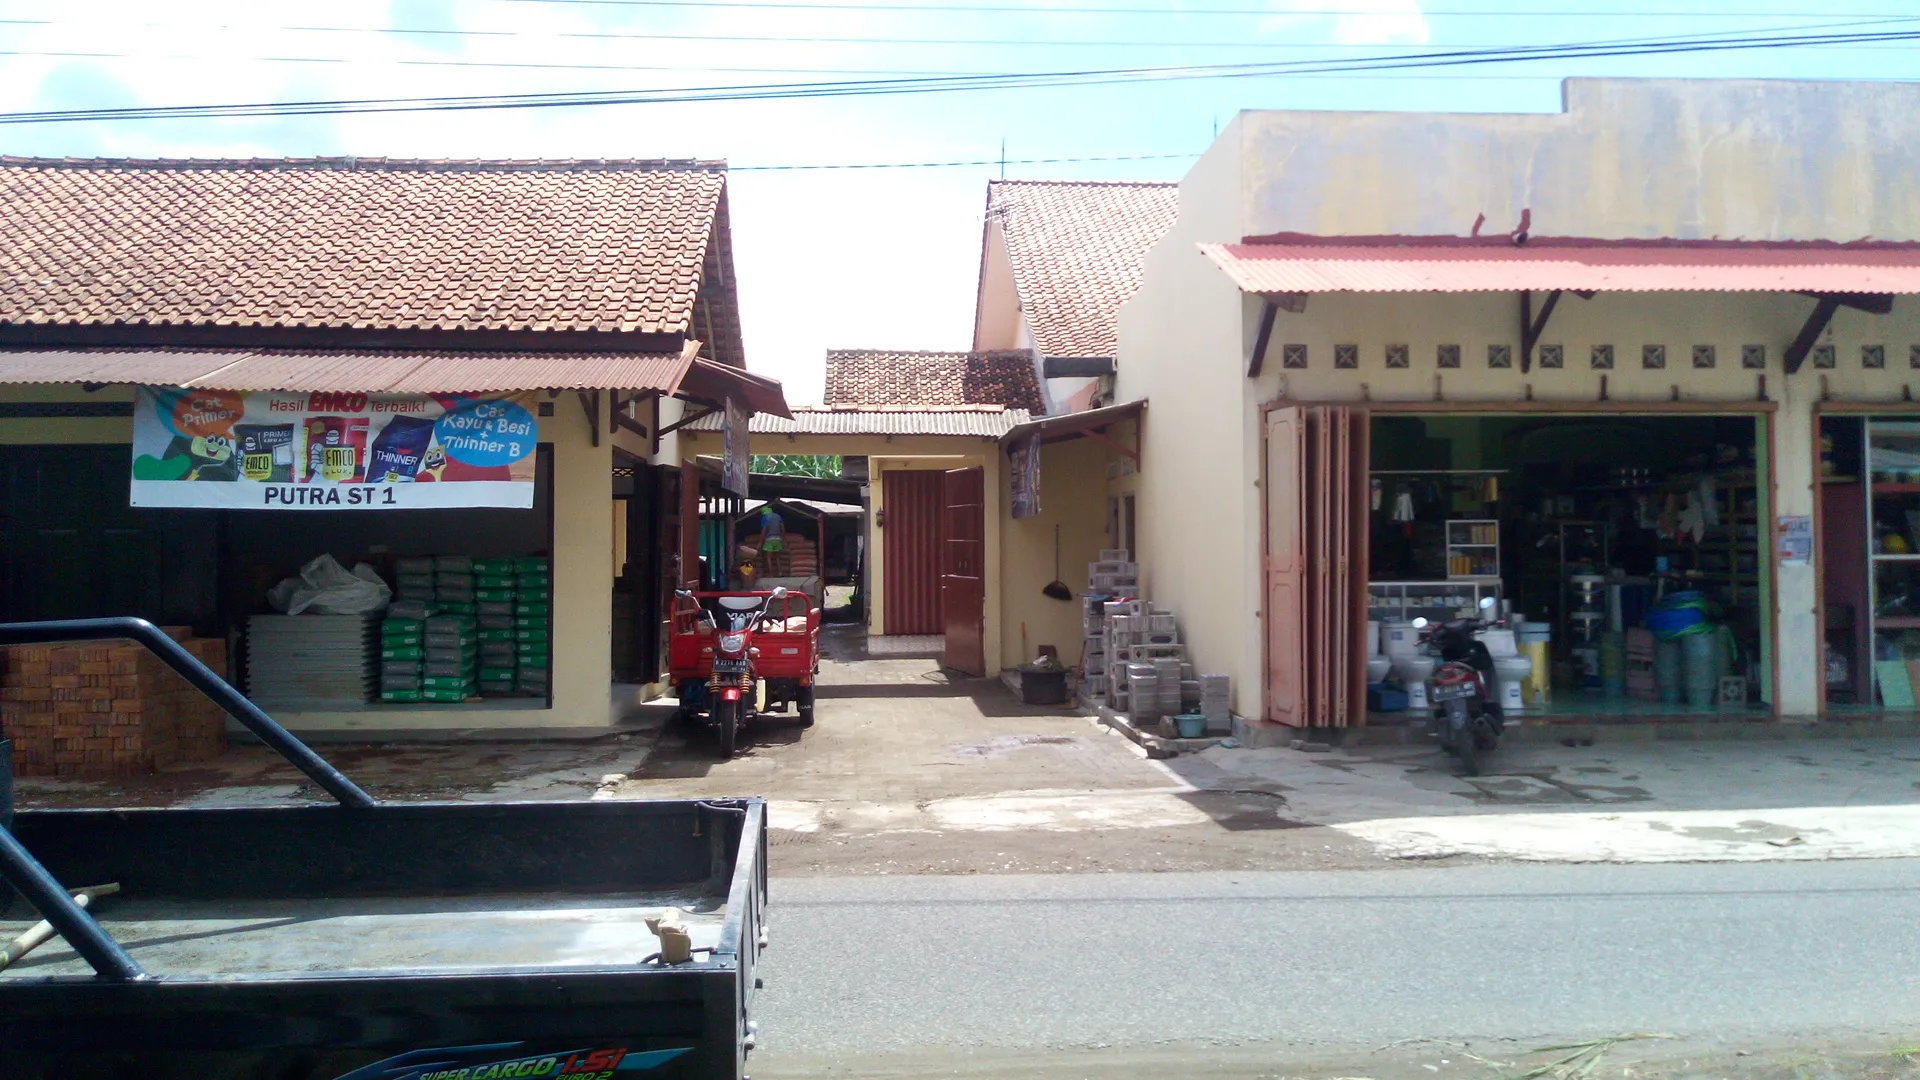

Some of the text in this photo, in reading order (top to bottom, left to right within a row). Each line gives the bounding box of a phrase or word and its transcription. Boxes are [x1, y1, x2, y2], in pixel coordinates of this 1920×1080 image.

[191, 396, 224, 412] Cat
[269, 391, 426, 413] Hasil EMCO Terbaik!
[182, 409, 236, 427] Primer
[442, 413, 531, 436] Kayu & Besi
[443, 435, 521, 457] Thinner B
[245, 455, 269, 470] EMCO
[325, 449, 354, 466] EMCO
[376, 450, 418, 466] THINNER
[264, 485, 397, 505] PUTRA ST 1
[471, 1057, 557, 1080] CARGO
